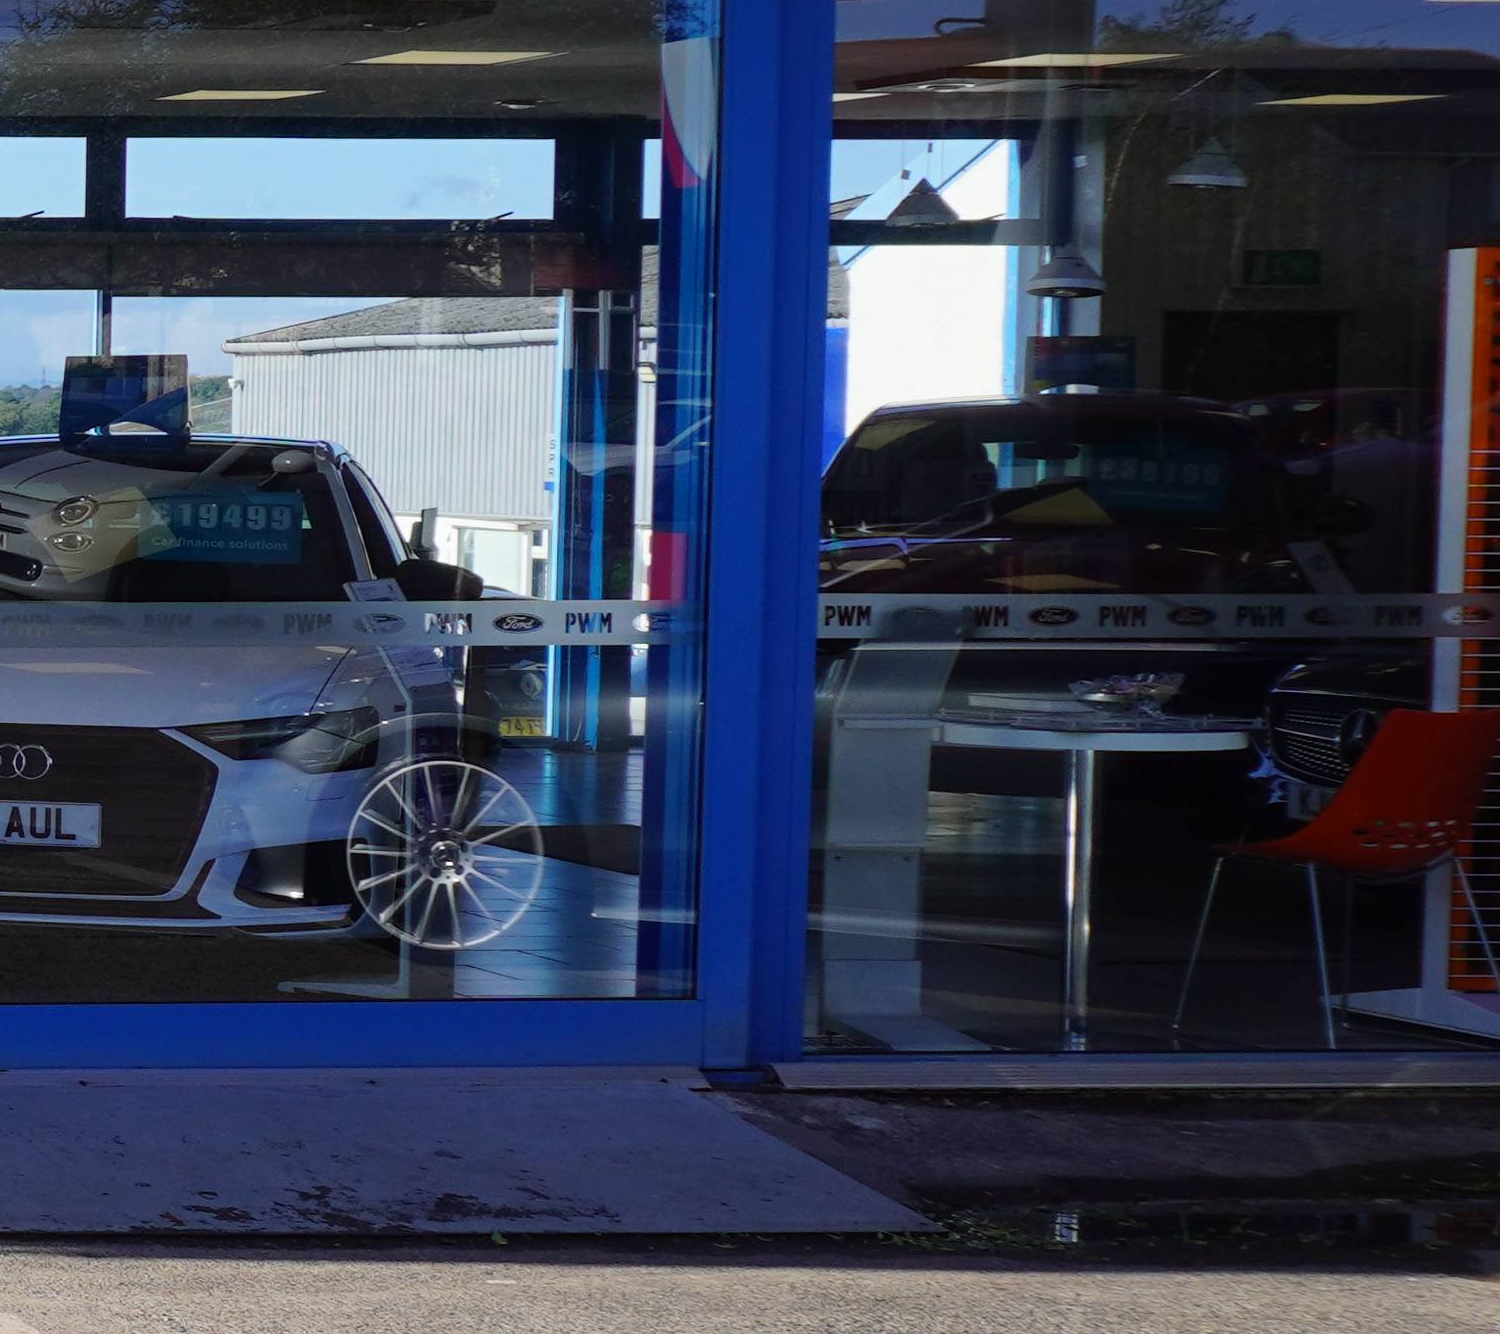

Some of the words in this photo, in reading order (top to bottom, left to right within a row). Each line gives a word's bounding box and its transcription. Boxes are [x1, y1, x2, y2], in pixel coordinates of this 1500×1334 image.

[151, 537, 175, 547] Car
[177, 537, 227, 549] finance
[228, 539, 290, 551] solutions
[565, 612, 612, 633] PWM
[825, 606, 871, 627] PWM
[1099, 606, 1146, 627] PWM
[4, 806, 77, 841] AUL
